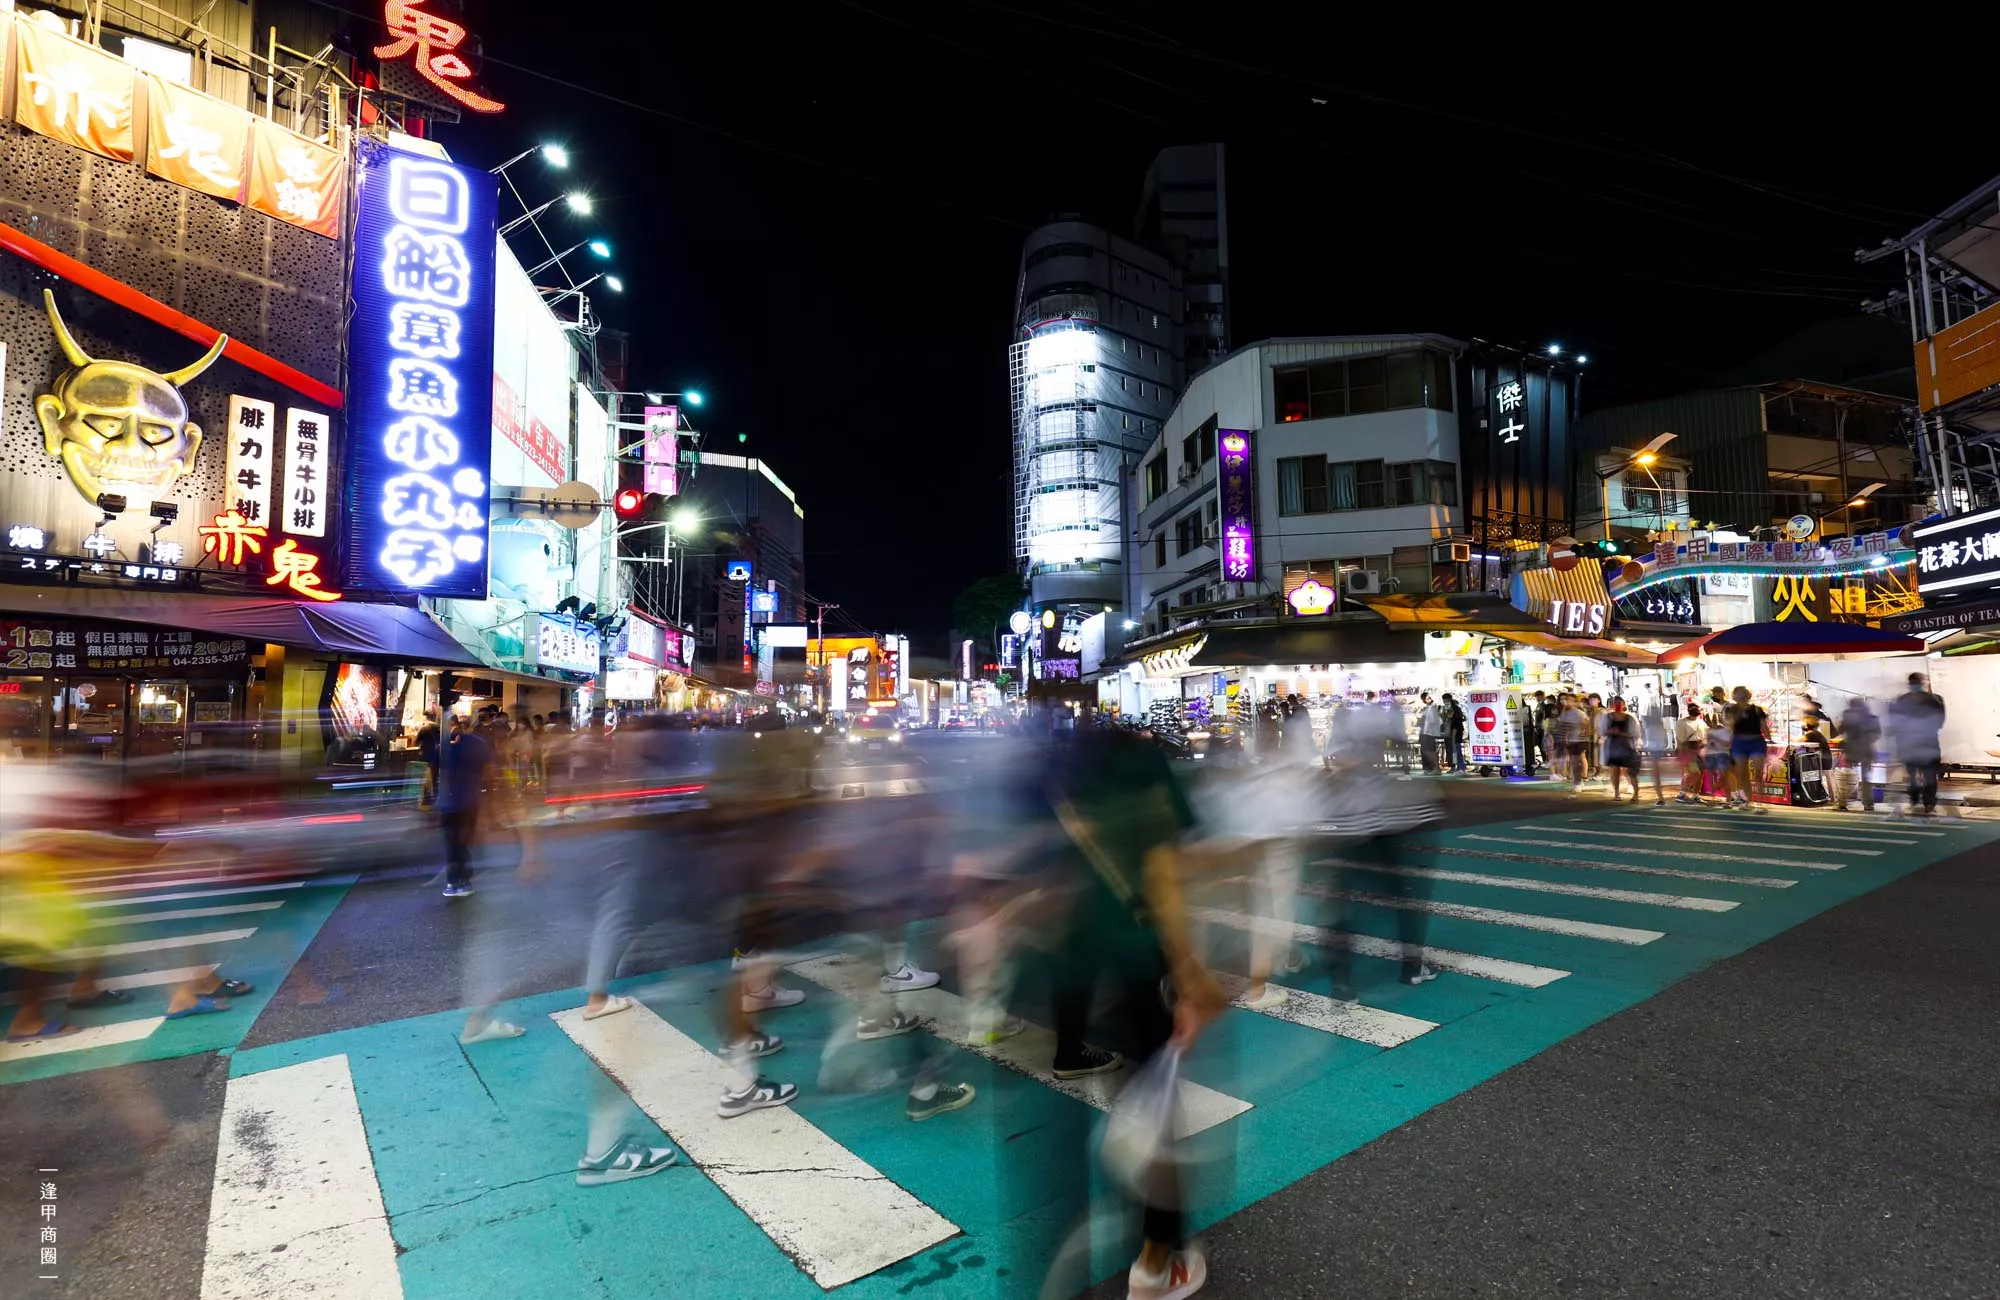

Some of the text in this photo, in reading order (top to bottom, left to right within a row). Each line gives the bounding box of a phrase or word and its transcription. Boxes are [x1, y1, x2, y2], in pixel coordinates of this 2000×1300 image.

[1496, 383, 1525, 443] 傑士
[237, 406, 265, 522] 腓力牛排
[293, 419, 319, 530] 無骨牛小排
[21, 557, 104, 574] ステーキ
[198, 509, 342, 602] 赤鬼
[1654, 534, 1889, 567] 逢甲國際觀光夜市
[1647, 599, 1695, 616] とうきょう
[1913, 615, 1956, 630] MASTER
[1960, 611, 1975, 623] OF
